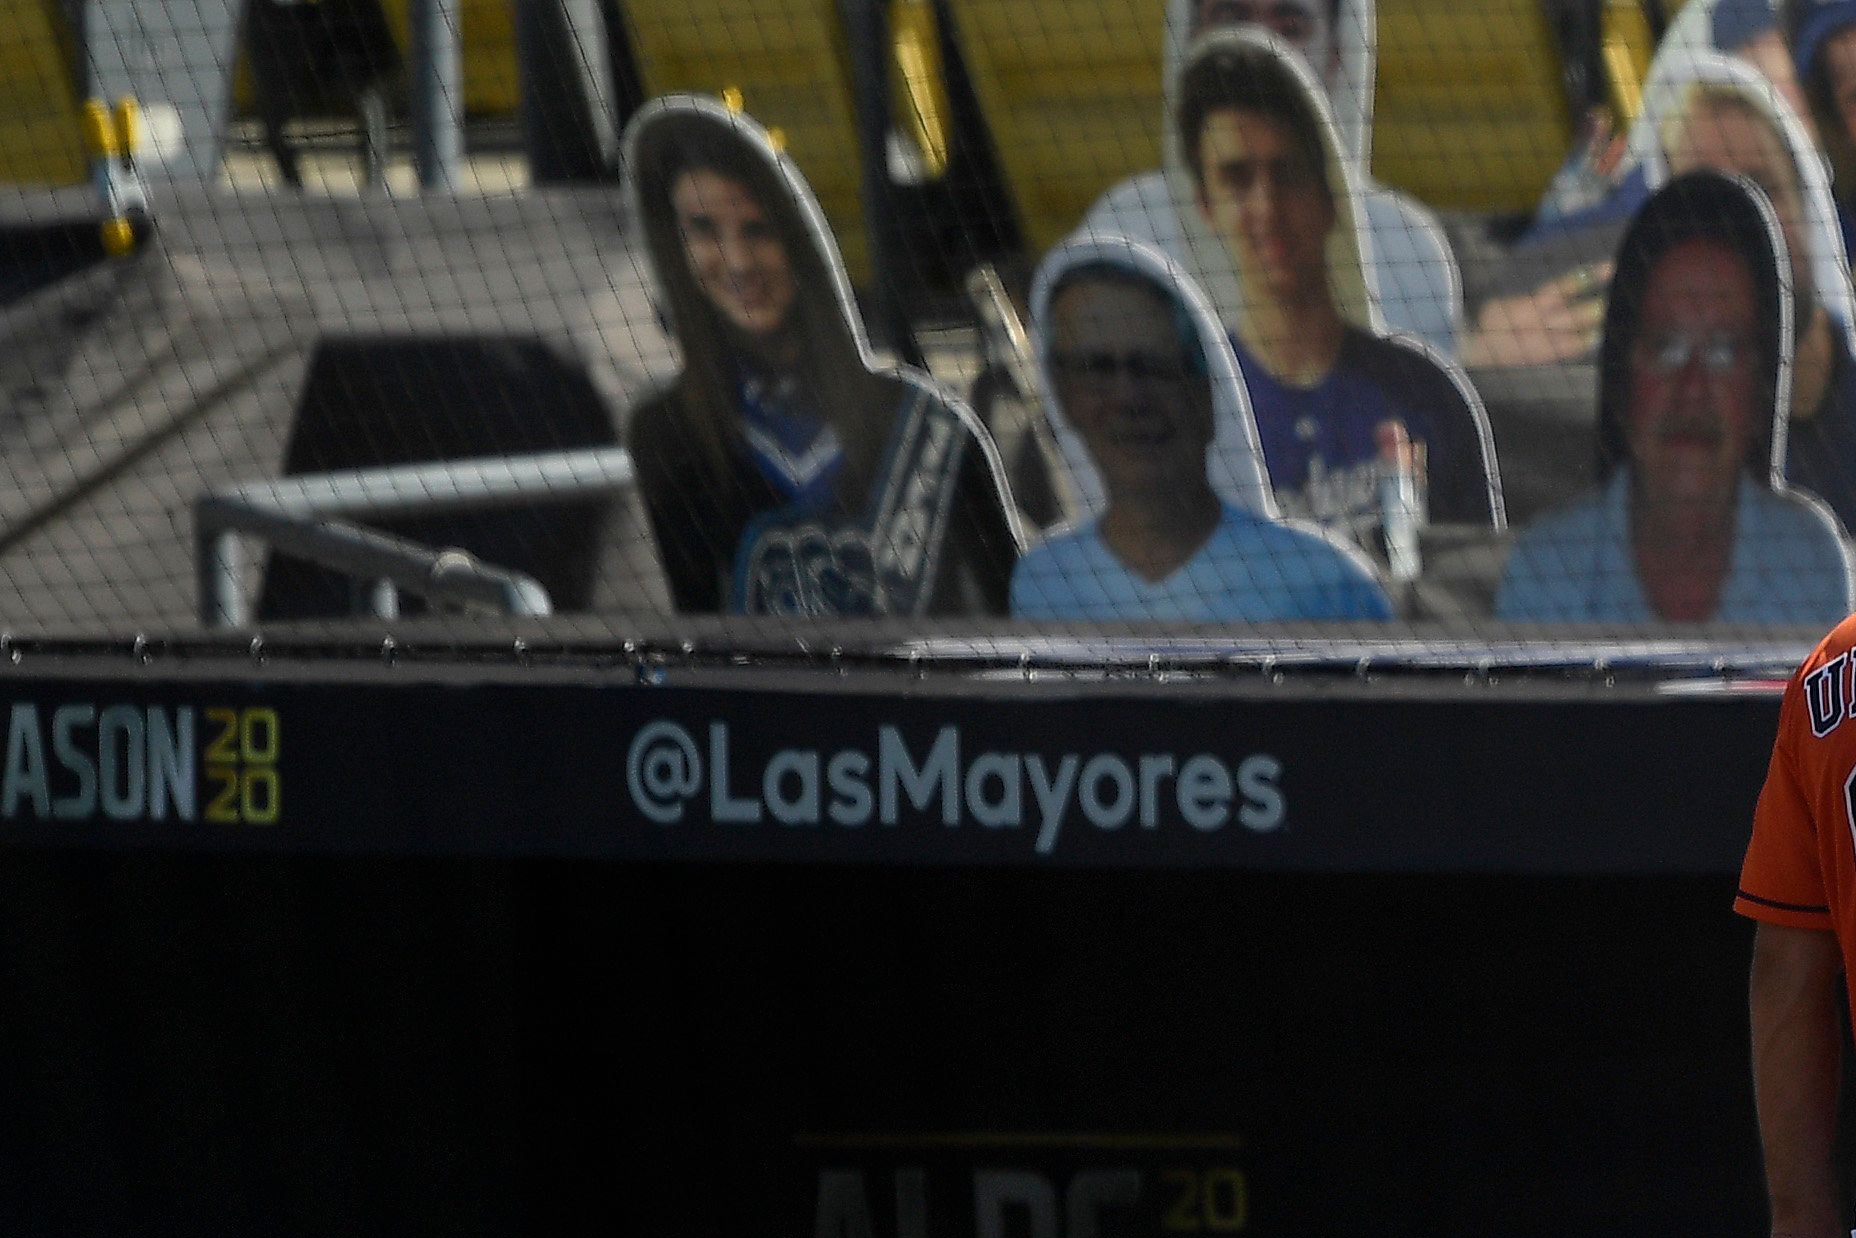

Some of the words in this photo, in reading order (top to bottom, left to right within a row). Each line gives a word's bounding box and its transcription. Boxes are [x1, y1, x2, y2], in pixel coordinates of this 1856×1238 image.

[203, 706, 282, 764] 20
[203, 766, 282, 825] 20
[626, 719, 1287, 854] @LasMayores
